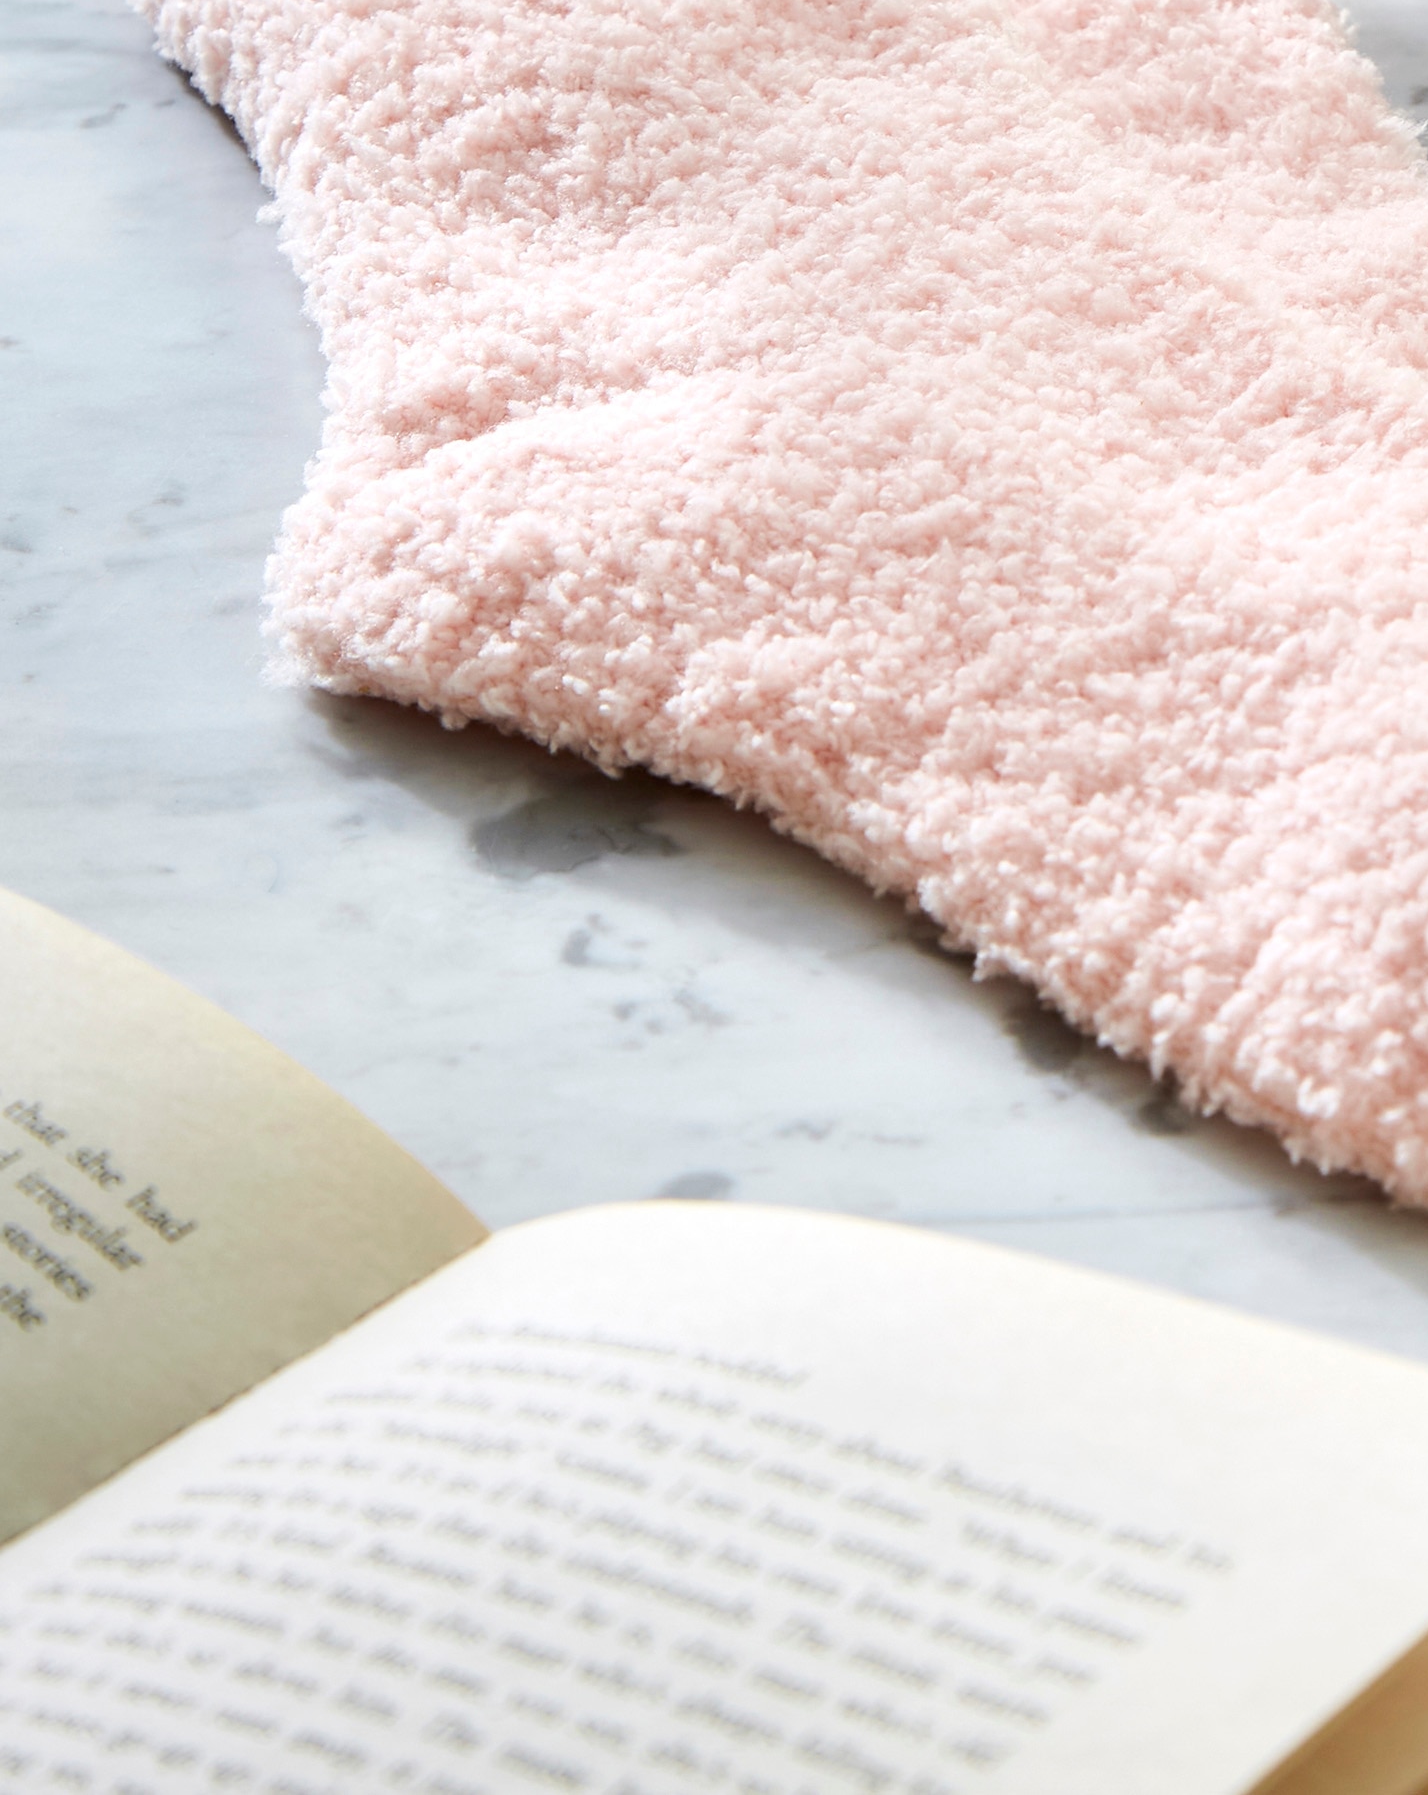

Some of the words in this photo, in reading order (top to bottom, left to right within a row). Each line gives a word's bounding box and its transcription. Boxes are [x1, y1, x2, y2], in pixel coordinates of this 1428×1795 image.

[14, 1170, 145, 1272] irregular
[67, 1148, 125, 1191] she
[125, 1183, 198, 1244] had
